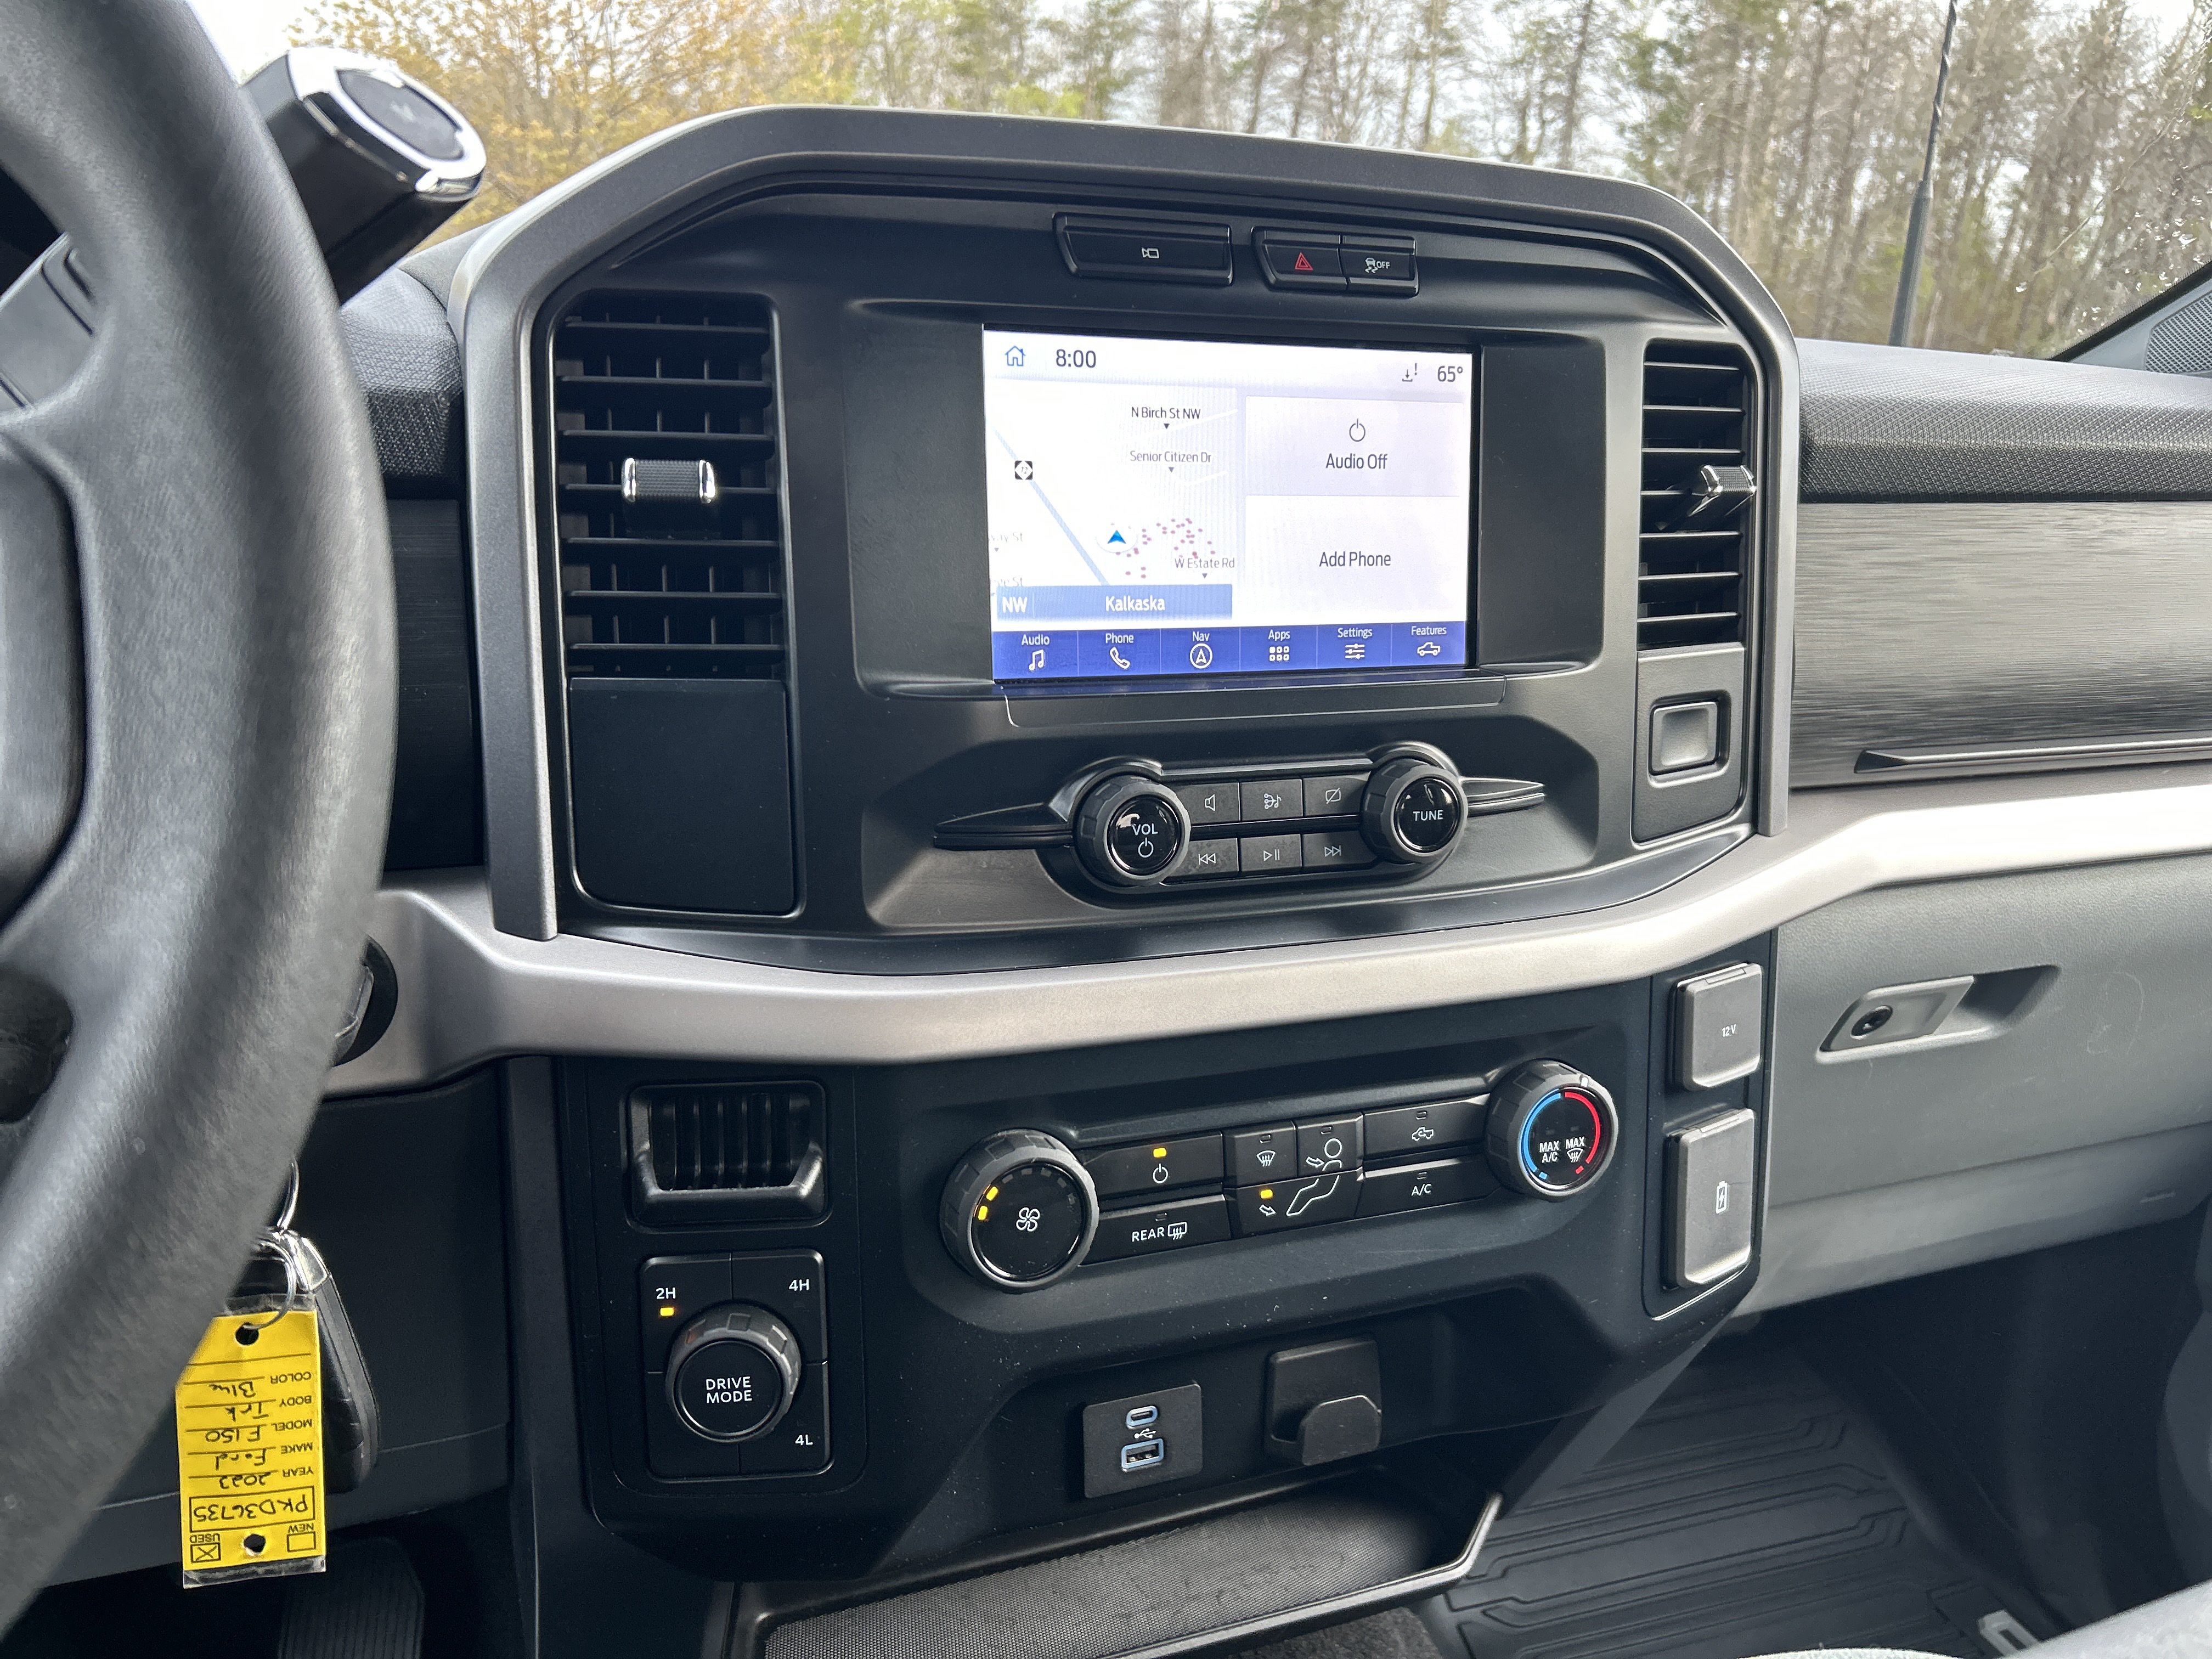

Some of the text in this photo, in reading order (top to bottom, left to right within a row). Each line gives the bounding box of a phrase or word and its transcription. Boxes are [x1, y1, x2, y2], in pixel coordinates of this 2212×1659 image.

[1376, 261, 1390, 269] OFF
[1055, 348, 1097, 368] 8:00
[1437, 365, 1464, 383] 65°
[1131, 406, 1201, 419] N Birch St NW
[1130, 450, 1212, 463] Senior Citizen Dr
[1325, 453, 1389, 470] Audio Off
[1012, 532, 1023, 543] St
[1175, 557, 1235, 569] W Estate Rd
[1319, 551, 1392, 567] Add Phone
[1001, 594, 1166, 613] NW Kalkaska
[1192, 630, 1210, 642] Nav
[1268, 629, 1291, 642] Apps
[1337, 627, 1373, 640] Settings
[1410, 625, 1447, 636] Features
[1021, 634, 1051, 646] Audio
[1105, 632, 1135, 644] Phone
[1413, 809, 1444, 821] TUNE
[1132, 823, 1158, 837] VOL
[1722, 1023, 1736, 1037] 12V
[1539, 1140, 1560, 1153] MAX
[1565, 1136, 1585, 1149] MAX
[1542, 1151, 1559, 1163] A/C
[1411, 1182, 1432, 1196] A/C
[1131, 1226, 1165, 1242] REAR
[788, 1279, 810, 1291] 4H
[656, 1287, 676, 1300] 2H
[269, 1371, 312, 1384] COLOR
[706, 1376, 752, 1390] DRIVE
[278, 1395, 312, 1407] BODY
[706, 1390, 753, 1404] MODE
[271, 1419, 313, 1431] MODEL
[795, 1435, 814, 1446] 4L
[280, 1442, 313, 1455] MAKE
[215, 1448, 267, 1471] Ford
[281, 1466, 314, 1478] YEAR
[287, 1522, 314, 1534] NEW
[189, 1532, 220, 1544] USED
